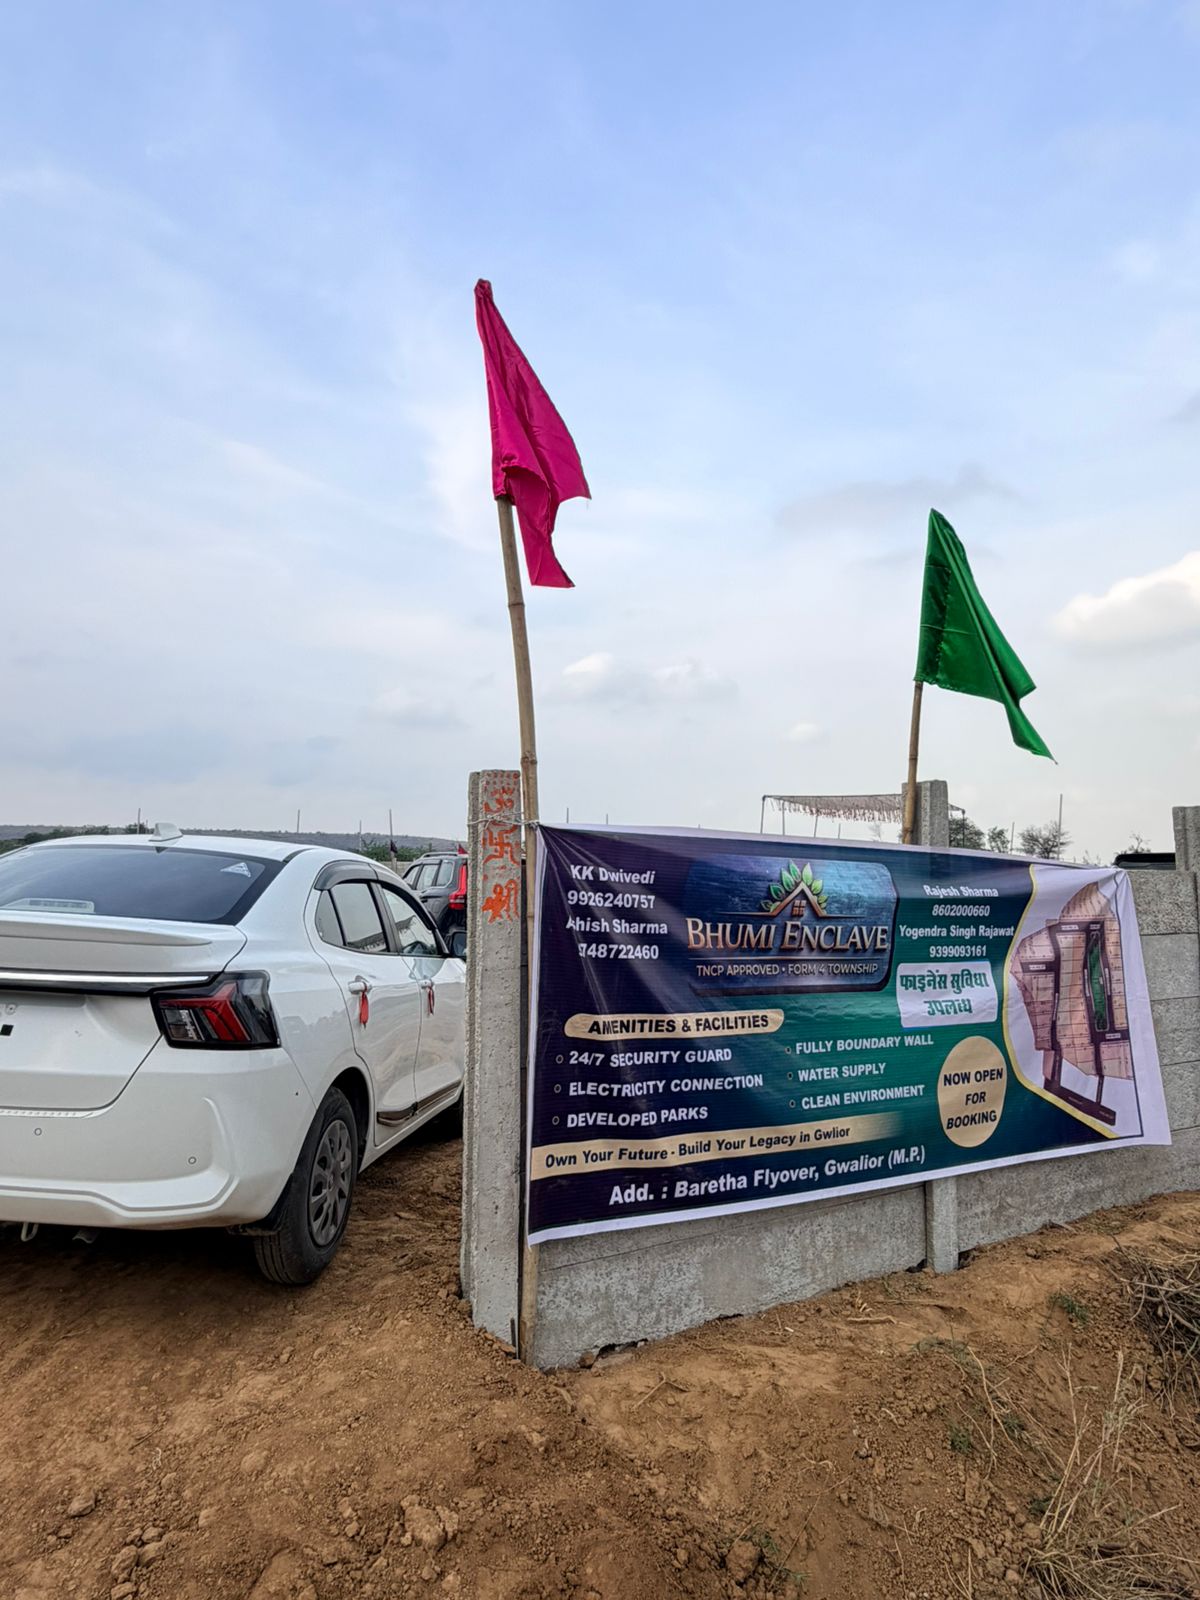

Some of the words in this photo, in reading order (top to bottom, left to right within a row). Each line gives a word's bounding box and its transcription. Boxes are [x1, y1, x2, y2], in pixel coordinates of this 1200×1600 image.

[570, 865, 594, 881] KK
[599, 867, 656, 884] Dwivedi
[567, 890, 656, 909] 9926240757
[923, 884, 960, 898] Rajesh
[960, 886, 999, 897] Sharma
[932, 904, 991, 917] 8602000660
[612, 918, 668, 935] Sharma
[685, 917, 777, 950] BHUMI
[780, 920, 890, 950] ENCLAVE
[899, 925, 947, 940] Yogendra
[950, 926, 976, 939] Singh
[978, 925, 1014, 939] Rajawat
[929, 945, 987, 958] 9399093161
[696, 965, 724, 976] TNCP
[726, 964, 780, 976] APPROVED
[788, 963, 816, 975] FORM
[827, 963, 879, 975] TOWNSHIP
[900, 970, 948, 992] फाइनेंस
[950, 968, 990, 994] सुविधा
[588, 1018, 676, 1035] AMENITIES
[681, 1018, 692, 1033] &
[695, 1014, 769, 1031] FACILITIES
[795, 1040, 834, 1055] FULLY
[837, 1036, 901, 1051] BOUNDARY
[903, 1034, 934, 1047] WALL
[569, 1051, 605, 1066] 24/7
[609, 1050, 680, 1067] SECURITY
[684, 1048, 733, 1063] GUARD
[798, 1067, 839, 1082] WATER
[842, 1062, 887, 1078] SUPPLY
[943, 1072, 972, 1086] NOW
[974, 1067, 1004, 1082] OPEN
[569, 1080, 666, 1097] ELECTRICITY
[670, 1074, 764, 1092] CONNECTION
[801, 1093, 841, 1110] CLEAN
[843, 1084, 926, 1105] ENVIRONMENT
[965, 1091, 987, 1106] FOR
[567, 1111, 658, 1128] DEVELOPED
[660, 1106, 709, 1124] PARKS
[946, 1110, 998, 1130] BOOKING
[545, 1154, 577, 1168] Own
[582, 1150, 614, 1163] Your
[618, 1148, 668, 1161] Future
[678, 1140, 712, 1157] Build
[716, 1138, 746, 1151] Your
[749, 1135, 796, 1149] Legacy
[799, 1131, 811, 1143] in
[813, 1127, 851, 1141] Gwlior
[609, 1183, 655, 1206] Add.
[674, 1173, 748, 1199] Baretha
[753, 1165, 819, 1190] Flyover,
[824, 1153, 884, 1177] Gwalior
[888, 1145, 926, 1170] (M.P.)
